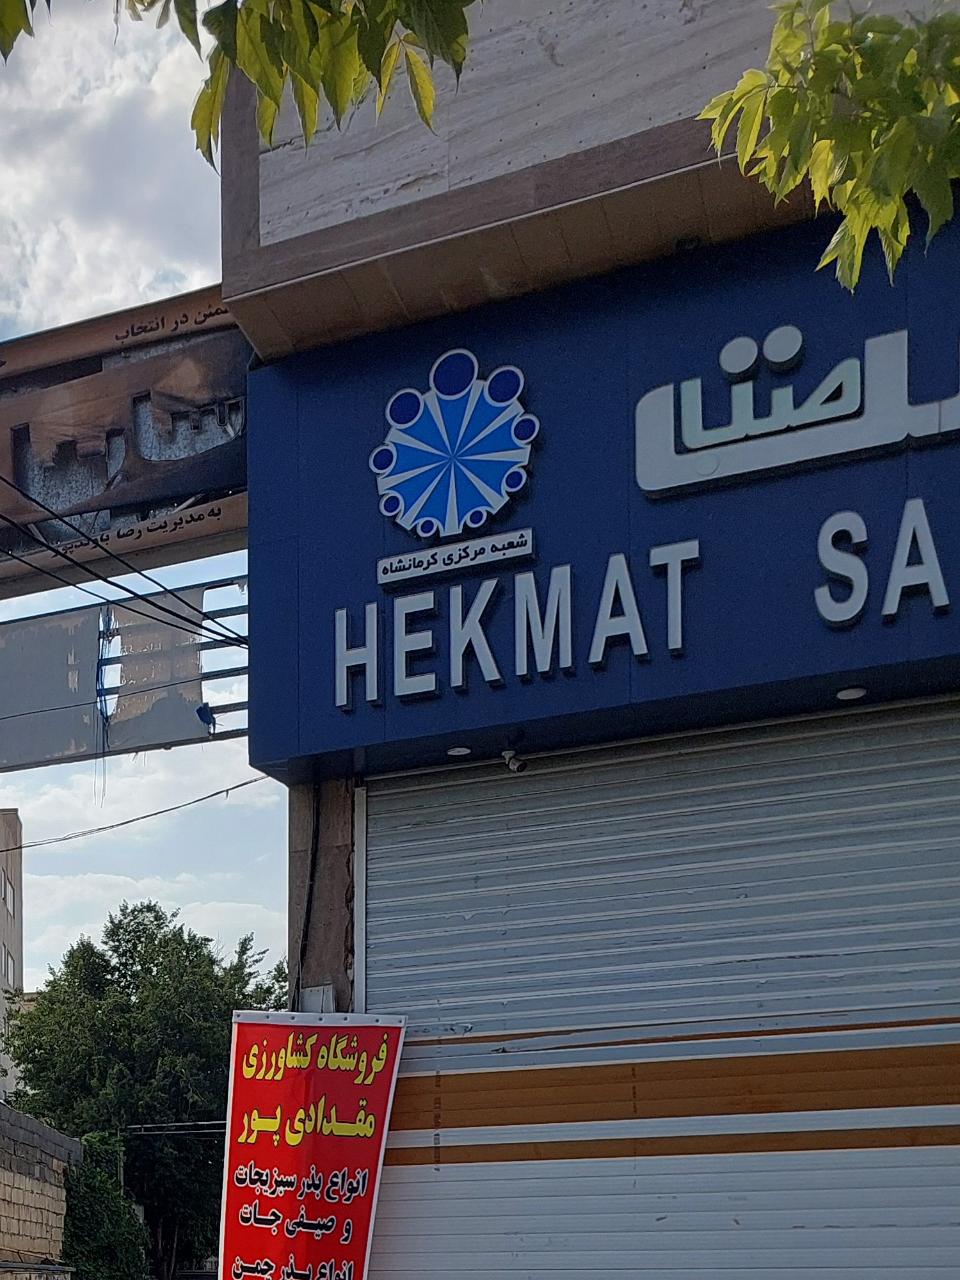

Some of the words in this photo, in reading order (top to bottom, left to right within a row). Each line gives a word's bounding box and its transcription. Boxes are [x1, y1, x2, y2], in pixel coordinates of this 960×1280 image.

[115, 315, 165, 344] انتخاب
[171, 313, 189, 332] در
[146, 514, 205, 533] مدیریت
[207, 507, 222, 521] به
[442, 546, 486, 567] مرکزی
[490, 533, 528, 556] شعبه
[381, 552, 438, 576] کرمانشاه
[334, 540, 700, 708] HEKMAT
[814, 498, 951, 622] SA
[243, 1032, 318, 1081] کشاورزی
[317, 1033, 388, 1085] فروشگاه
[237, 1104, 282, 1147] پور
[285, 1096, 375, 1146] مقدادی
[234, 1160, 297, 1197] سبزیجات
[297, 1165, 323, 1199] بذر
[324, 1167, 369, 1204] انواع
[239, 1200, 282, 1235] جات
[285, 1205, 337, 1239] صیفی
[340, 1219, 352, 1244] و
